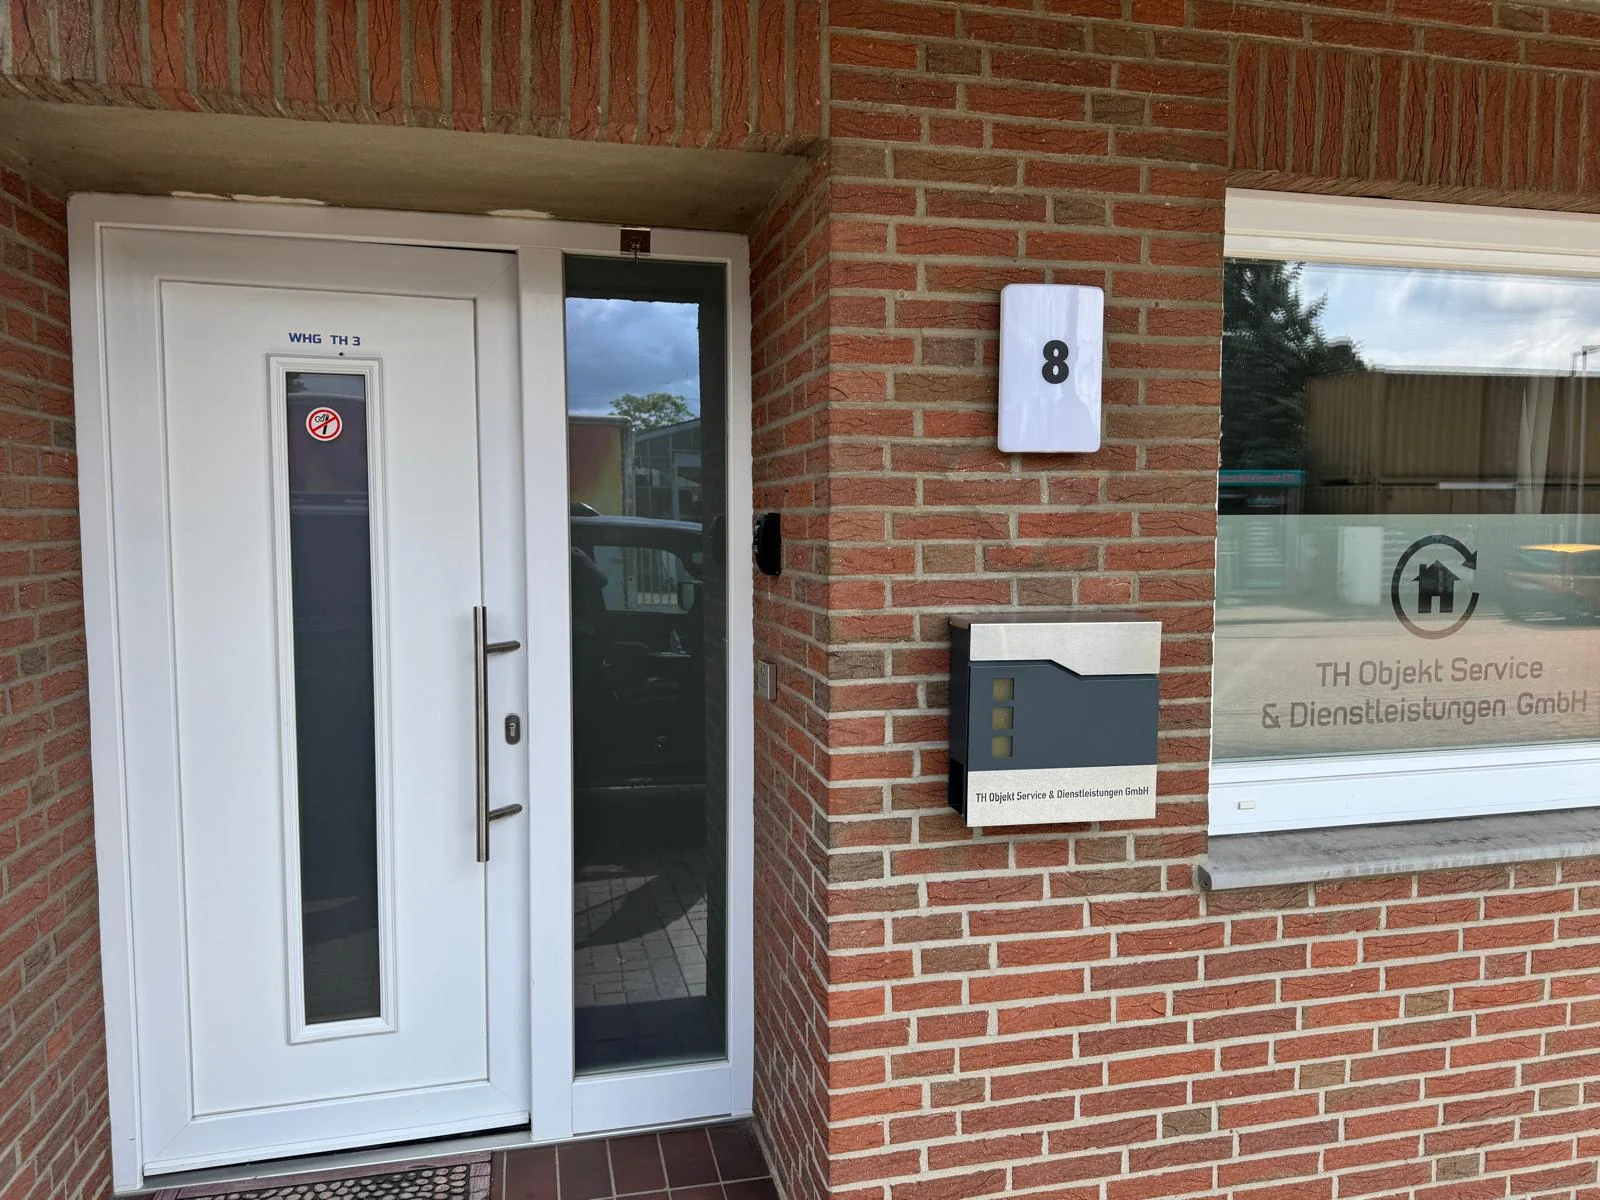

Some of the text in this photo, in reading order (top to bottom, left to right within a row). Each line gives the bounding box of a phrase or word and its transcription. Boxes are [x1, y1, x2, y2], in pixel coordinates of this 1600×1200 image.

[288, 332, 361, 346] WHG TH 3
[1042, 339, 1069, 384] 8
[1316, 655, 1544, 691] TH Objekt Service
[1261, 689, 1588, 729] & Dienstleistungen GmbH
[975, 786, 1149, 804] TH Objekt Service & Dienstleistungen GmbH
